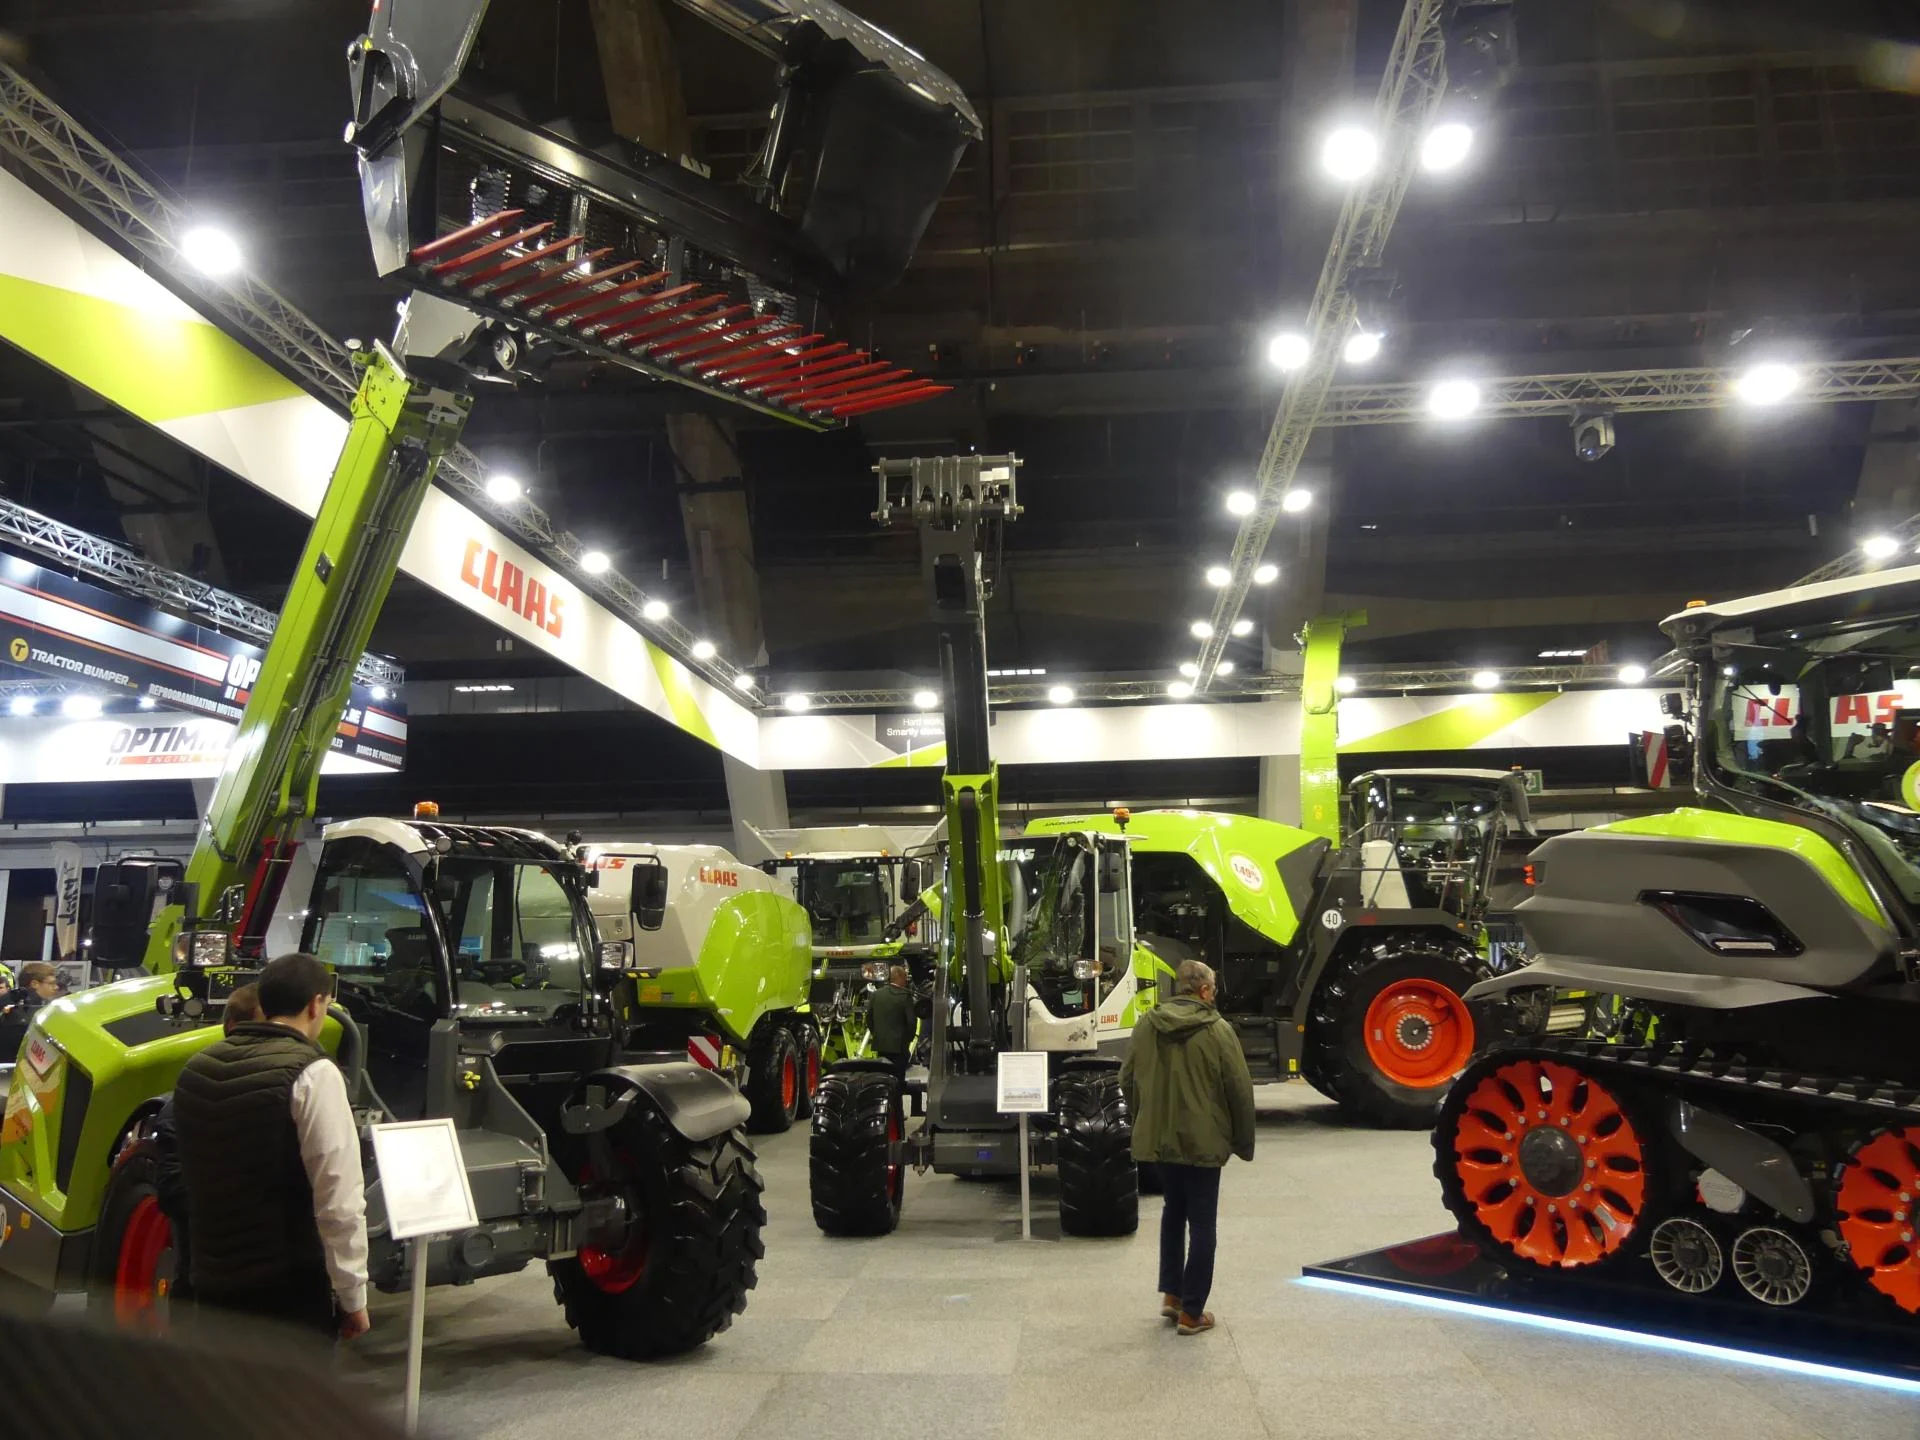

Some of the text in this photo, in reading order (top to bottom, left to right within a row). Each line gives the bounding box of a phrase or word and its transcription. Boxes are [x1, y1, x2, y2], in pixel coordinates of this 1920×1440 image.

[461, 537, 565, 639] CLAAS
[31, 648, 82, 672] TRACTOR
[83, 665, 129, 686] BUMPER
[227, 654, 261, 689] OP
[1744, 694, 1904, 727] CLAS
[1325, 912, 1338, 925] 40
[1100, 1014, 1118, 1024] CLAAS
